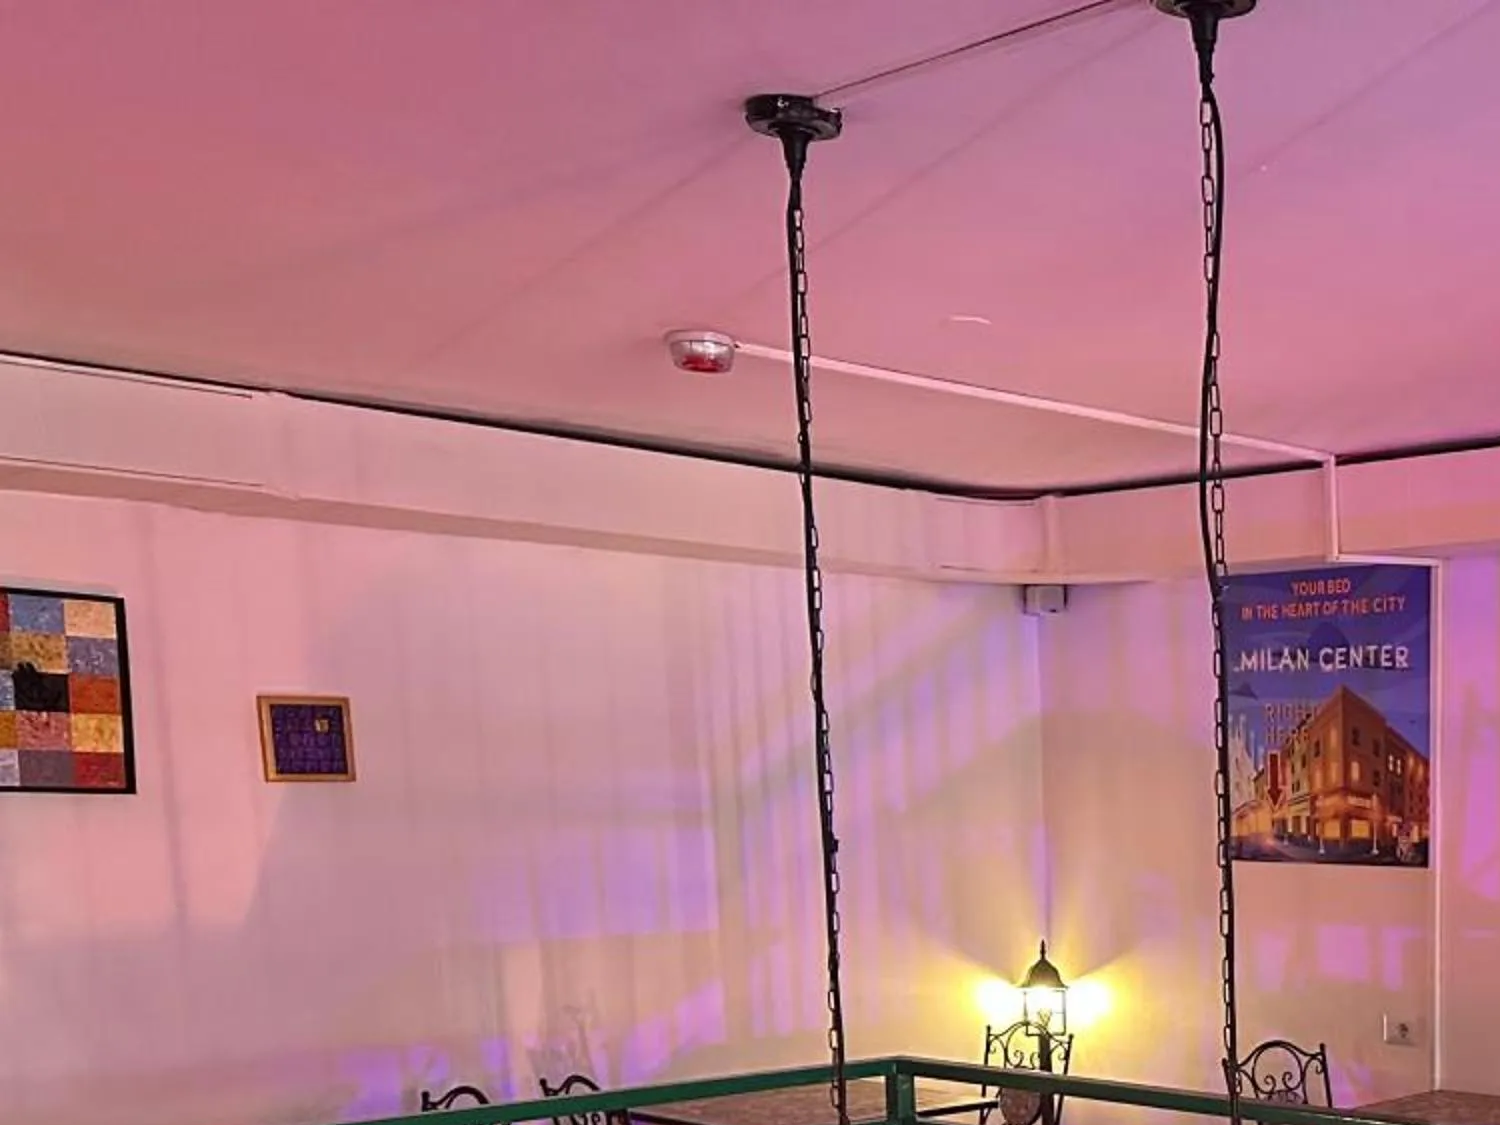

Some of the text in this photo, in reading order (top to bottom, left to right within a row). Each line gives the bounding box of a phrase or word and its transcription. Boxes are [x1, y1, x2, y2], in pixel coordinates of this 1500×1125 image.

[1291, 577, 1350, 597] YOUR BED
[1241, 593, 1406, 620] IN THE HEART OF THE CITY
[1239, 645, 1410, 673] MILAN CENTER
